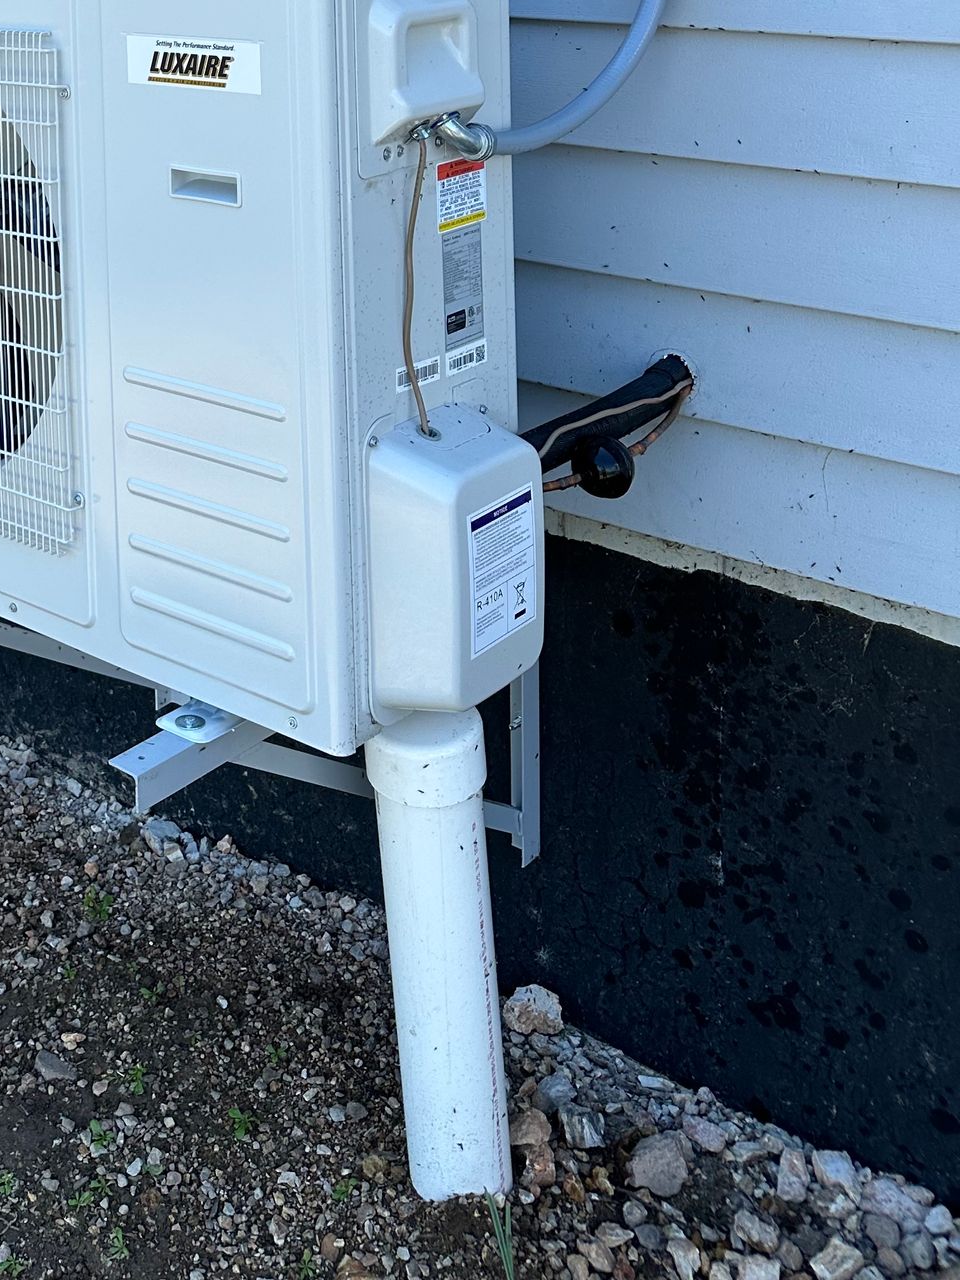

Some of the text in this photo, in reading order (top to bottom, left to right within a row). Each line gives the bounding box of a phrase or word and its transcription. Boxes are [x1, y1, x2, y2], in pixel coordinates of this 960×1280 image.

[156, 40, 172, 48] Setting
[150, 51, 231, 79] LUXAIRE
[477, 589, 503, 611] R-410A
